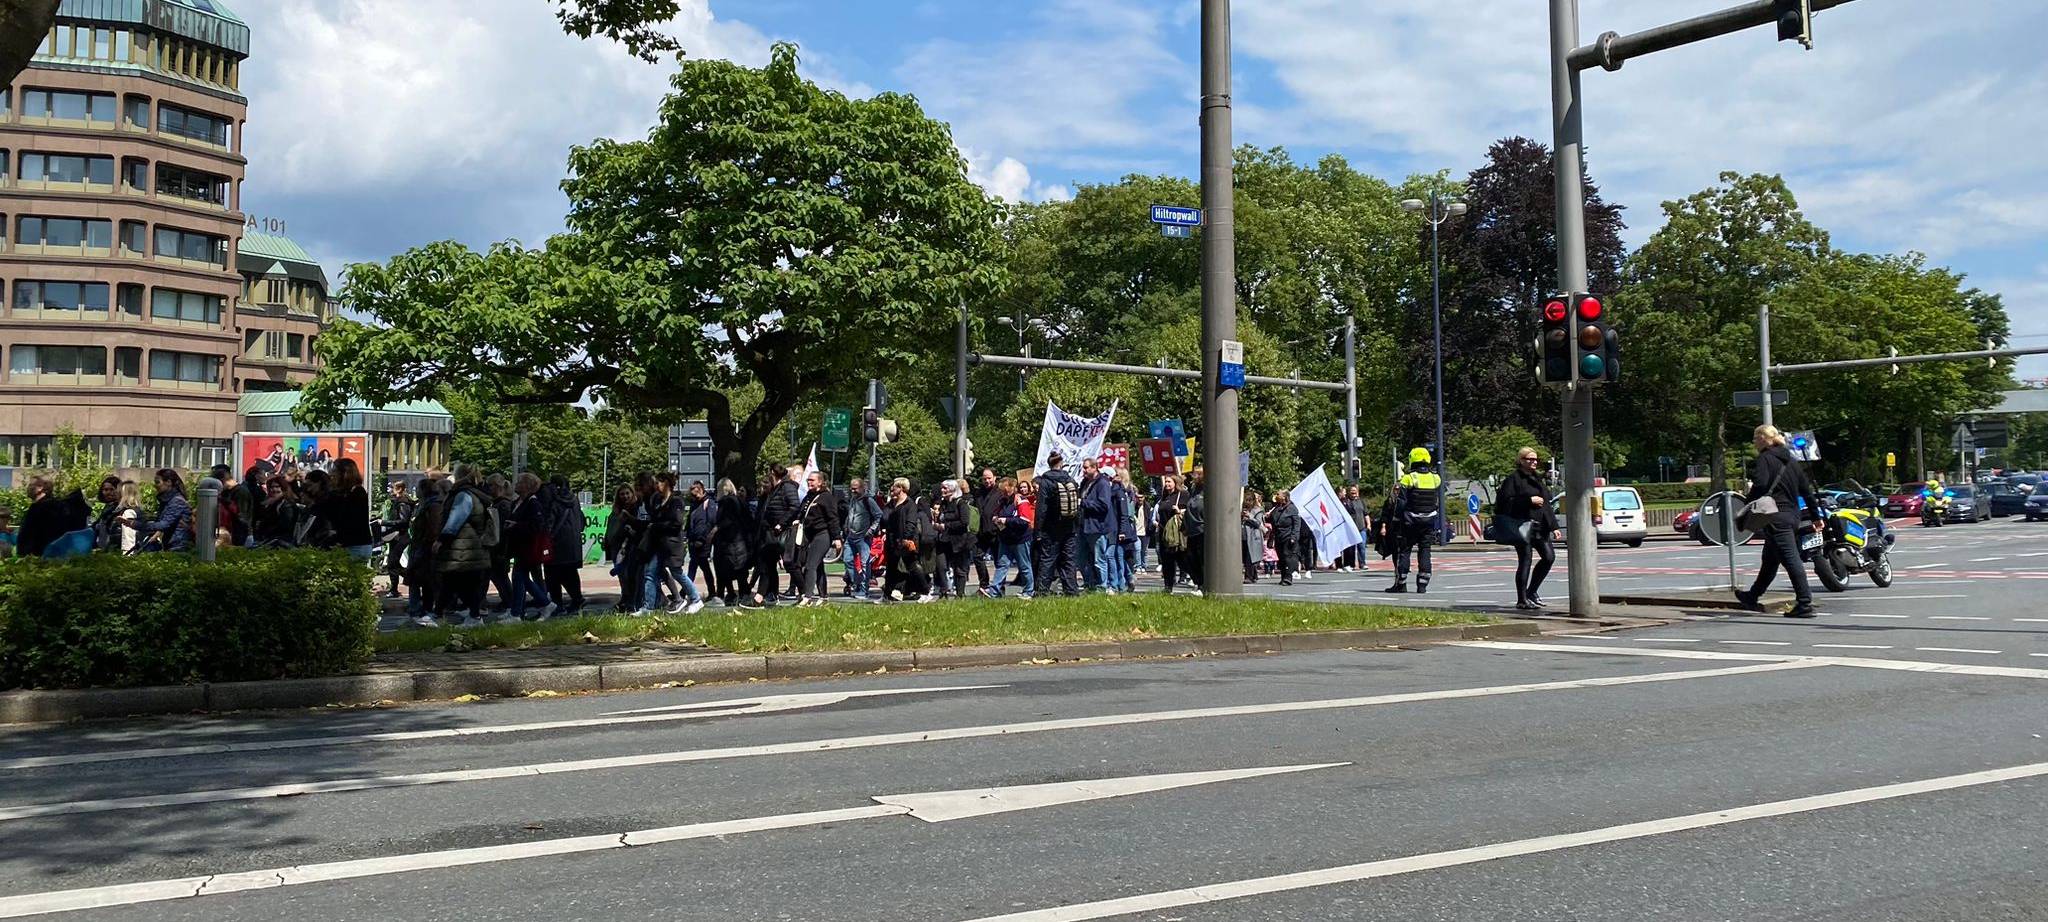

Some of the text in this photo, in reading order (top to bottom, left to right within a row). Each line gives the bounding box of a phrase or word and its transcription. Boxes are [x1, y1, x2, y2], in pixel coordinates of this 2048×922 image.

[1155, 207, 1197, 222] Hiltropwall
[262, 217, 285, 236] 101
[1167, 225, 1182, 235] 15-1
[1056, 422, 1089, 438] DARF
